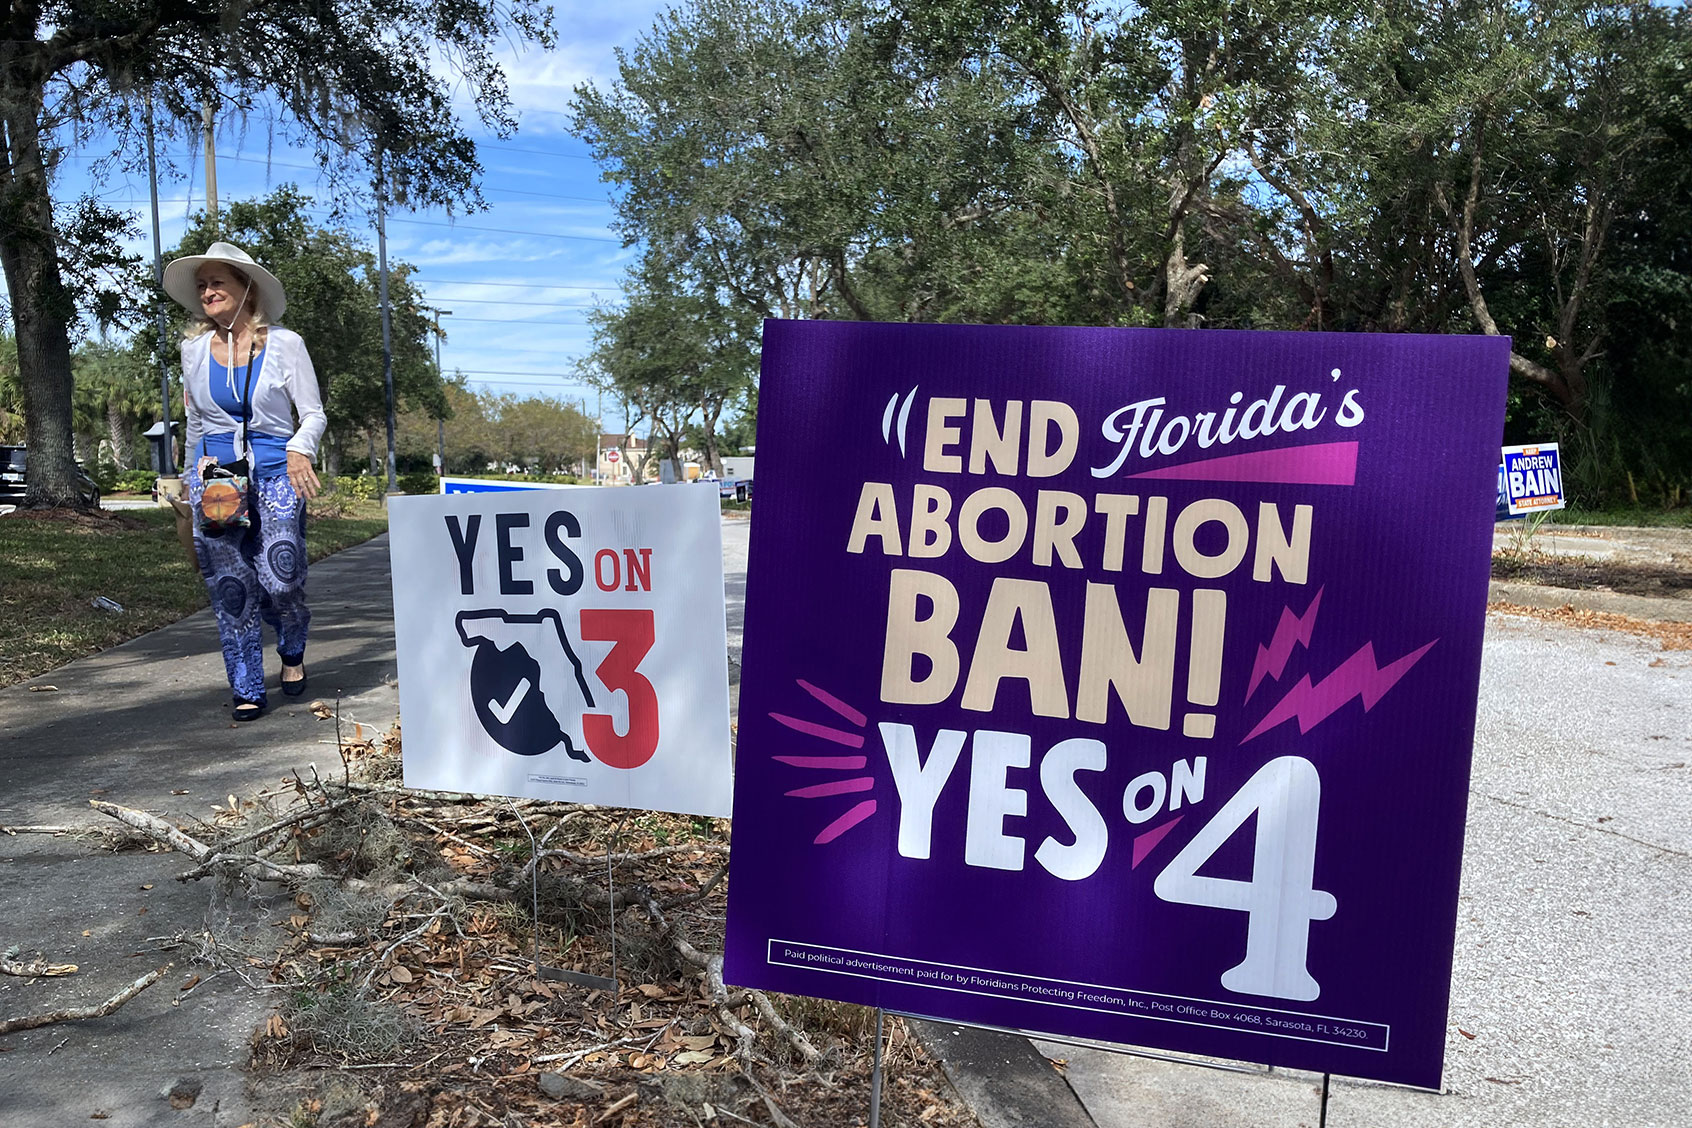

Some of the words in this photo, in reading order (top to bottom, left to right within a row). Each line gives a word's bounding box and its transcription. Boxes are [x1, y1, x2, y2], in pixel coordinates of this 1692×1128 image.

[923, 396, 1080, 478] END
[1091, 368, 1365, 478] Florida's
[1512, 455, 1553, 471] ANDREW
[847, 481, 1313, 585] ABORTION
[1509, 468, 1559, 497] BAIN
[445, 510, 584, 595] YES
[595, 548, 653, 592] ON
[580, 608, 660, 770] 3
[880, 568, 1227, 739] BAN!
[878, 722, 1109, 881] YES
[1123, 756, 1207, 825] ON
[1154, 755, 1338, 1002] 4
[784, 949, 806, 960] Paid
[808, 954, 844, 964] political
[846, 959, 914, 976] advertisement
[917, 969, 939, 980] paid
[940, 971, 954, 981] for
[956, 974, 969, 985] by
[971, 976, 1019, 990] Floridians
[1021, 983, 1075, 1000] Protecting
[1077, 991, 1126, 1006] Freedom,
[1128, 998, 1149, 1010] Inc.,
[1151, 1001, 1173, 1012] Post
[1176, 1005, 1208, 1016] Office
[1210, 1010, 1230, 1020] Box
[1233, 1013, 1263, 1025] 4068,
[1265, 1017, 1314, 1032] Sarasota,
[1317, 1024, 1330, 1034] FL
